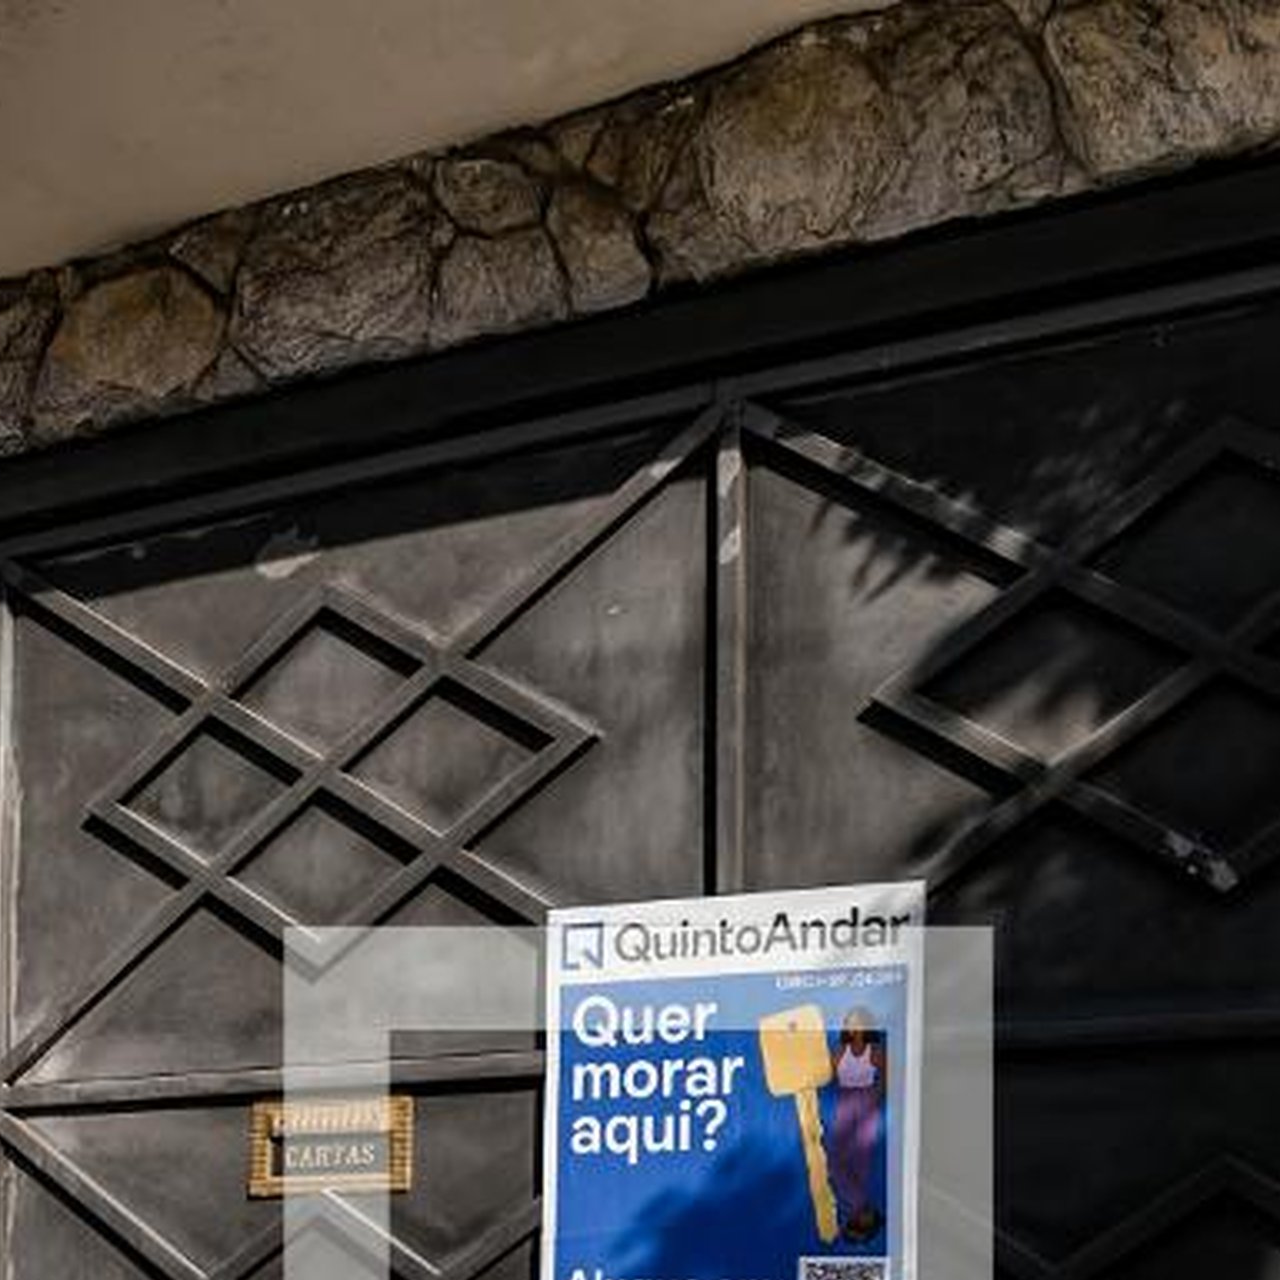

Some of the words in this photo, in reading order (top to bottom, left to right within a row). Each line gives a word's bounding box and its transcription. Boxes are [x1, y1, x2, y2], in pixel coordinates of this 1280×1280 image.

[615, 907, 911, 964] QuintoAndar
[574, 995, 718, 1047] Quer
[574, 1055, 745, 1100] morar
[285, 1144, 376, 1168] CARTAS
[572, 1100, 728, 1164] aqui?
